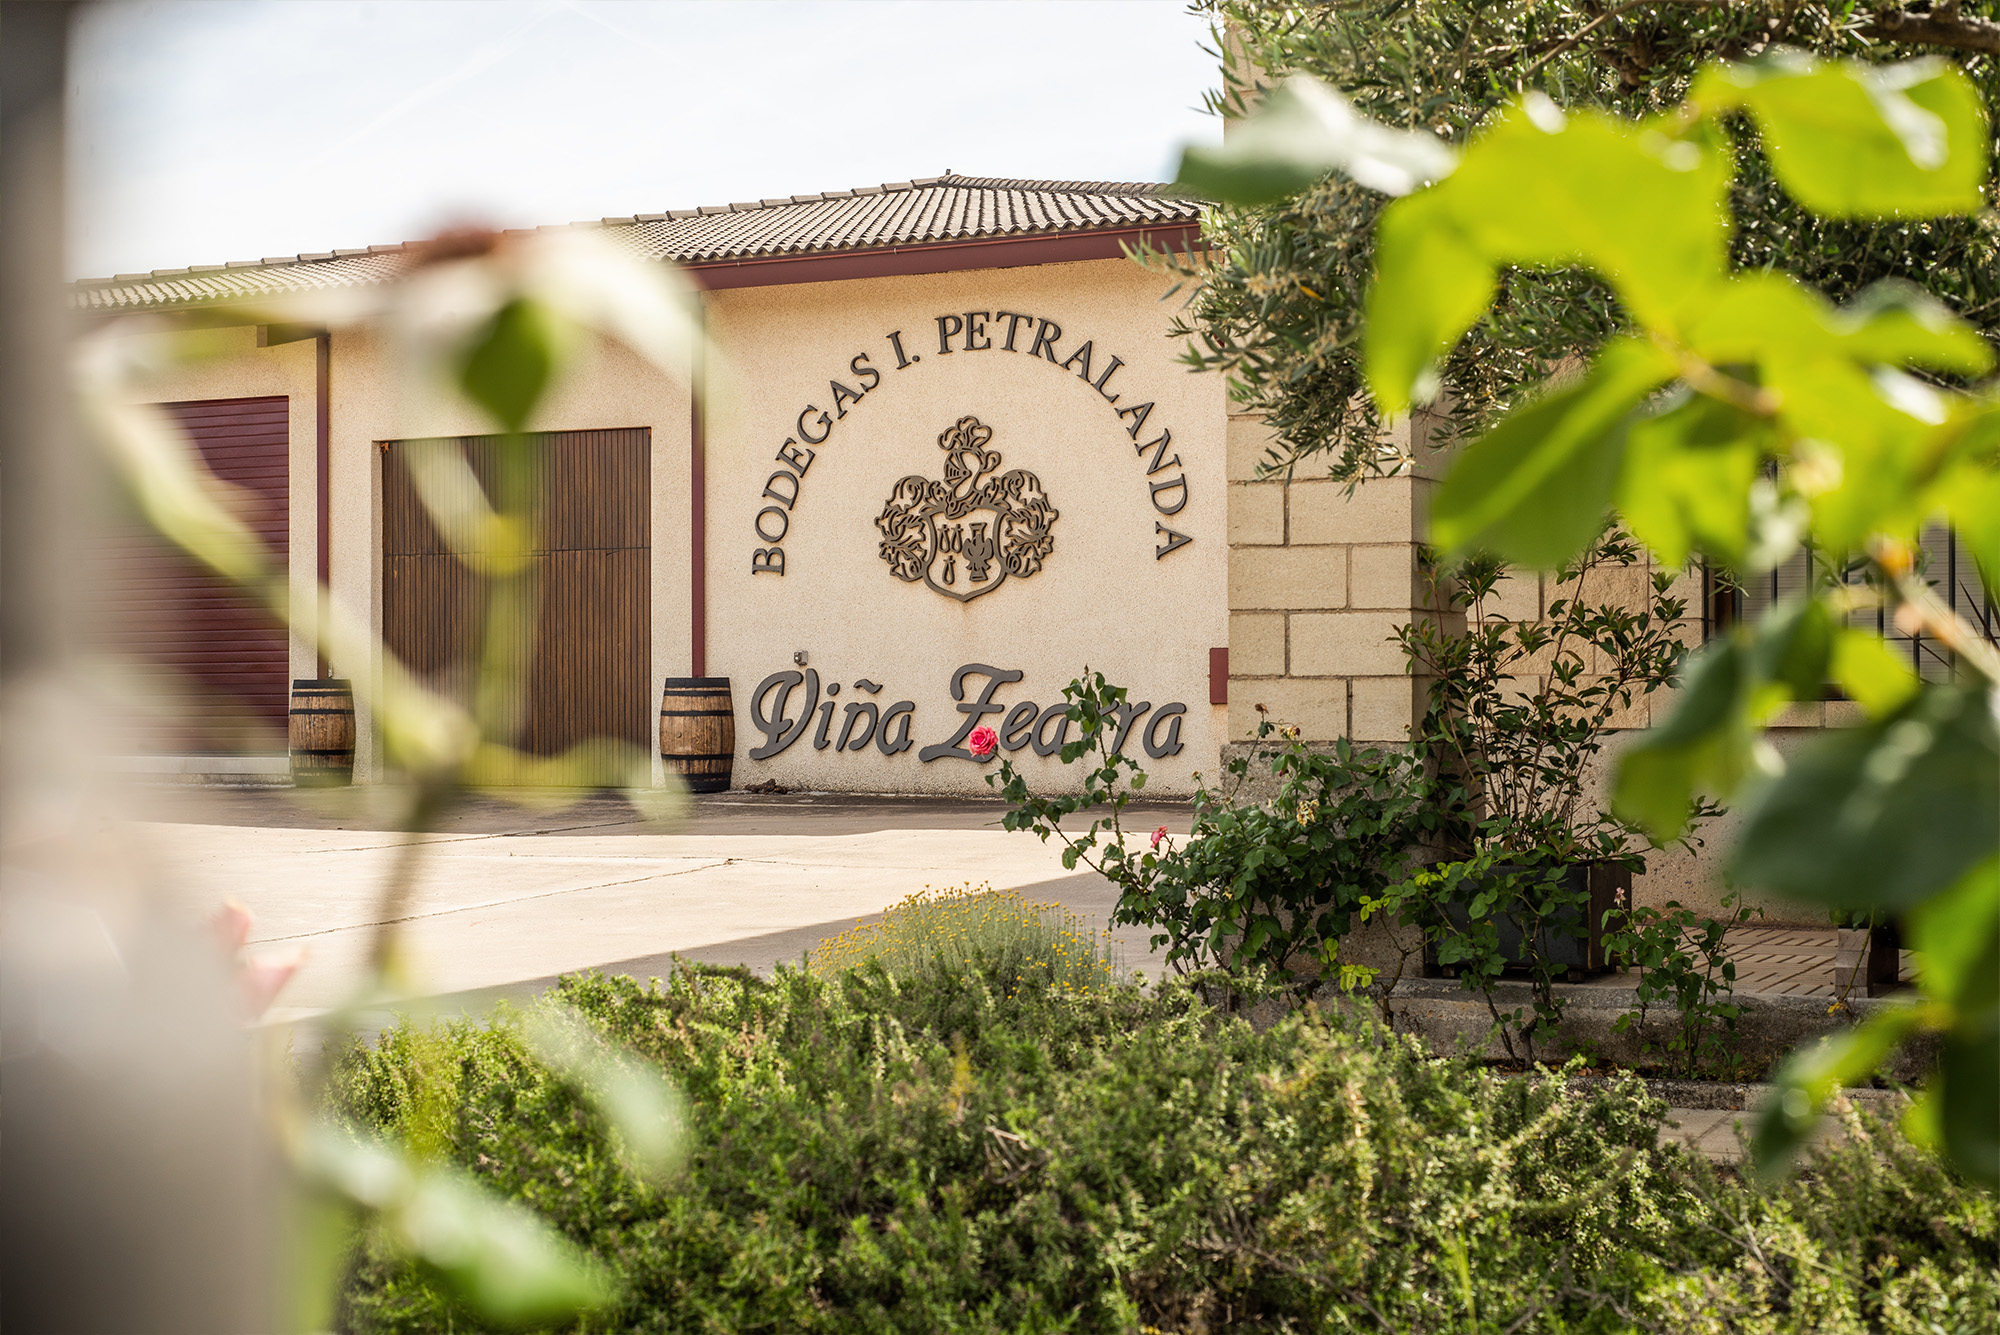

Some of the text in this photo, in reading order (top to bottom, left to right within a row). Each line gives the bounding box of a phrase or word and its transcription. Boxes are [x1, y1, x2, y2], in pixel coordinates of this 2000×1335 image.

[752, 311, 1193, 576] BODEGAS I. PETRALANDA
[749, 668, 915, 760] Viña
